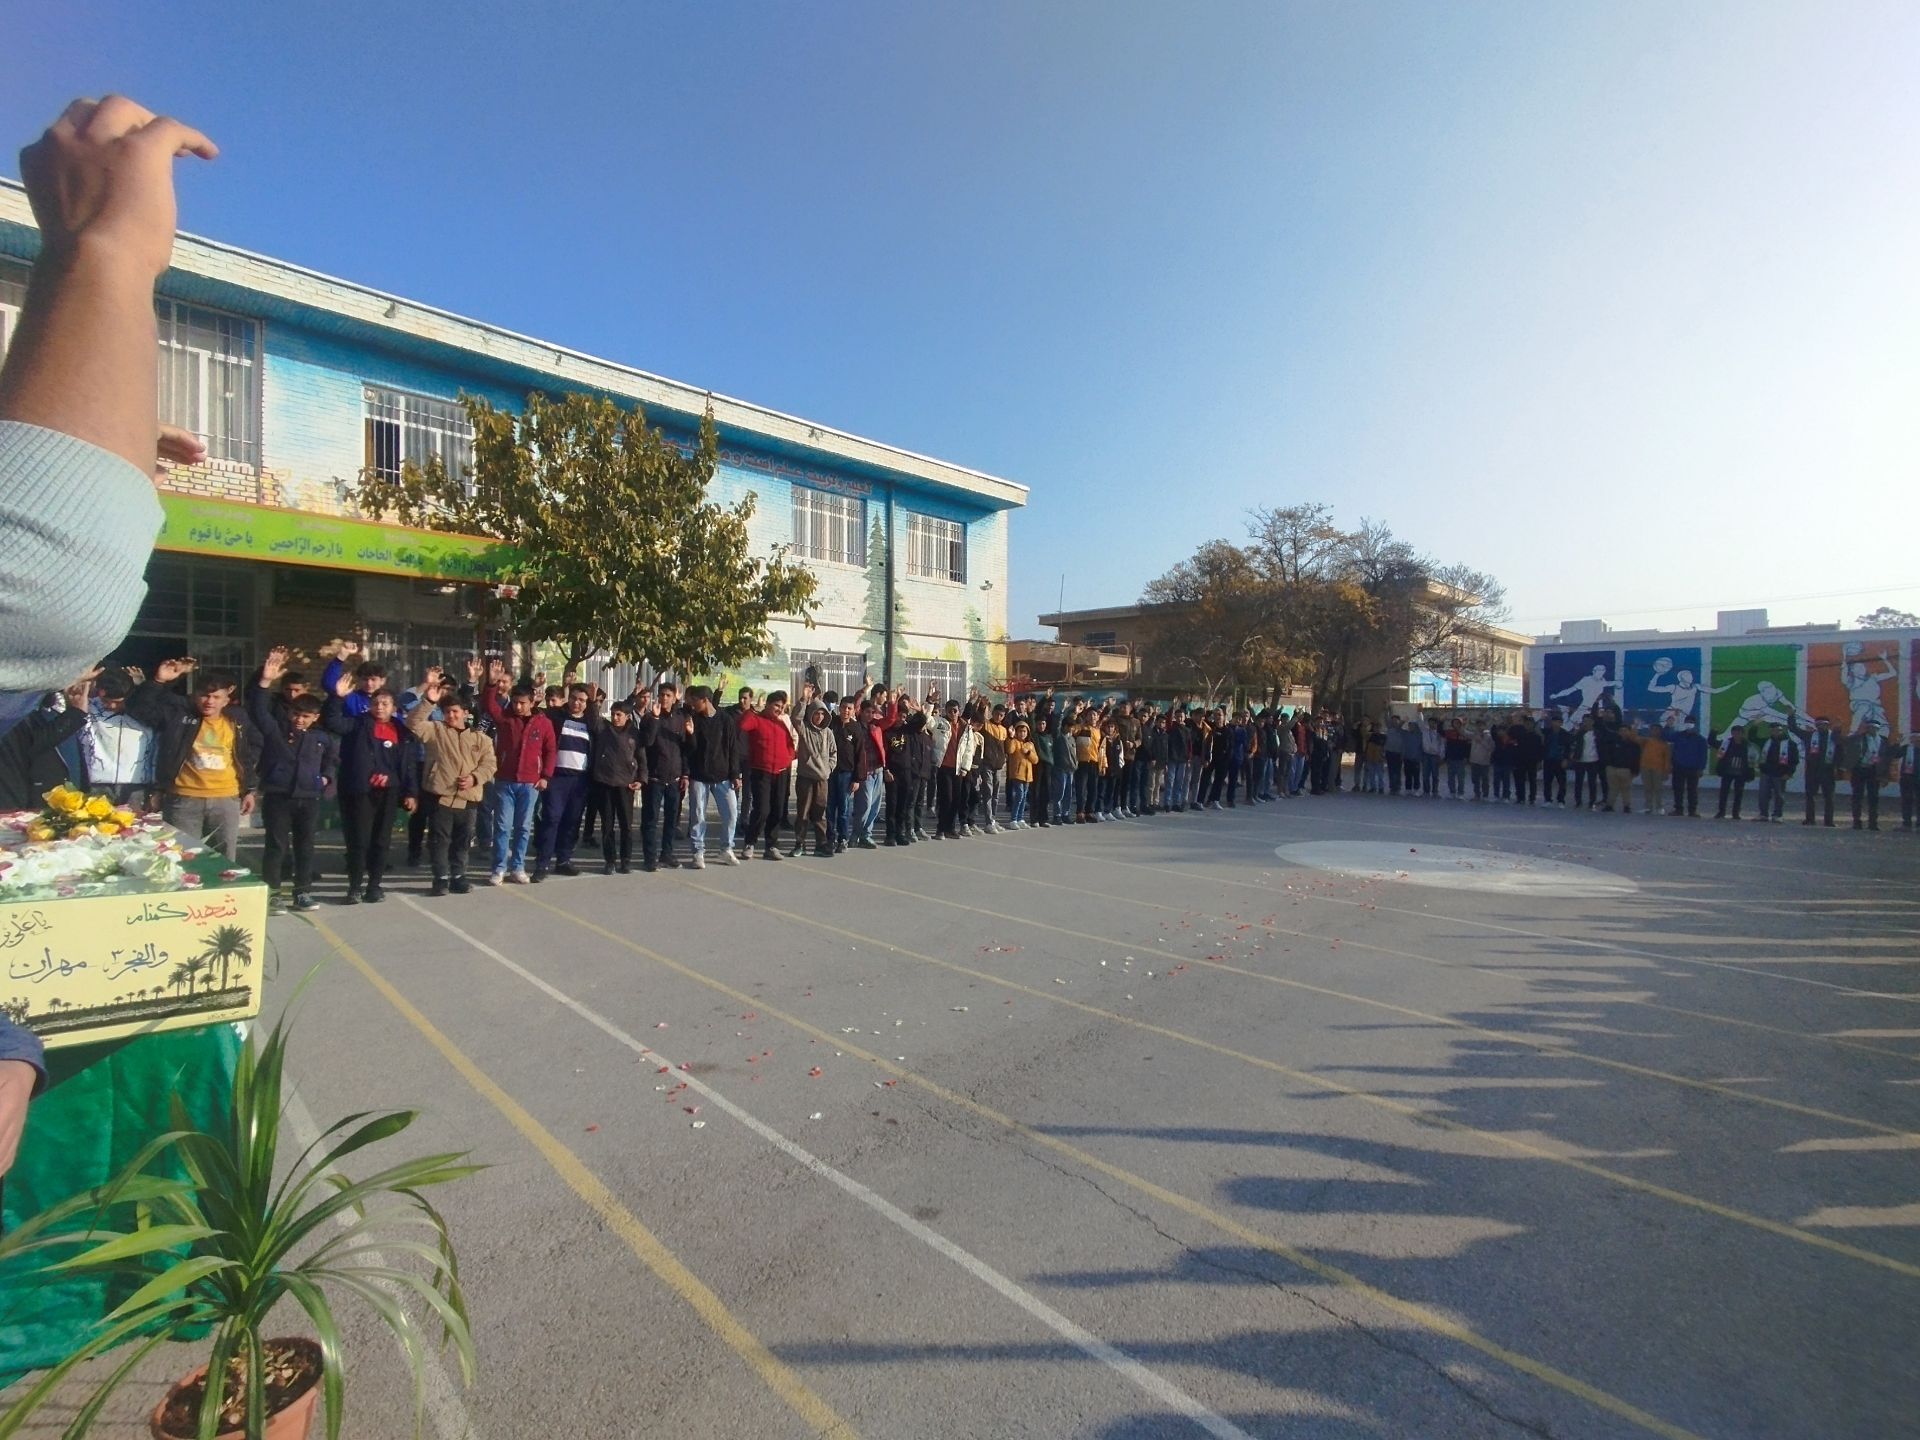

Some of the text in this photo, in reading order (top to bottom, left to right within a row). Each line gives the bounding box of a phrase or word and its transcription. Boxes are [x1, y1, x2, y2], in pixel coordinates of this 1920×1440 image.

[181, 894, 238, 926] شهید
[8, 946, 88, 984] مهران
[107, 942, 169, 981] والفجر
